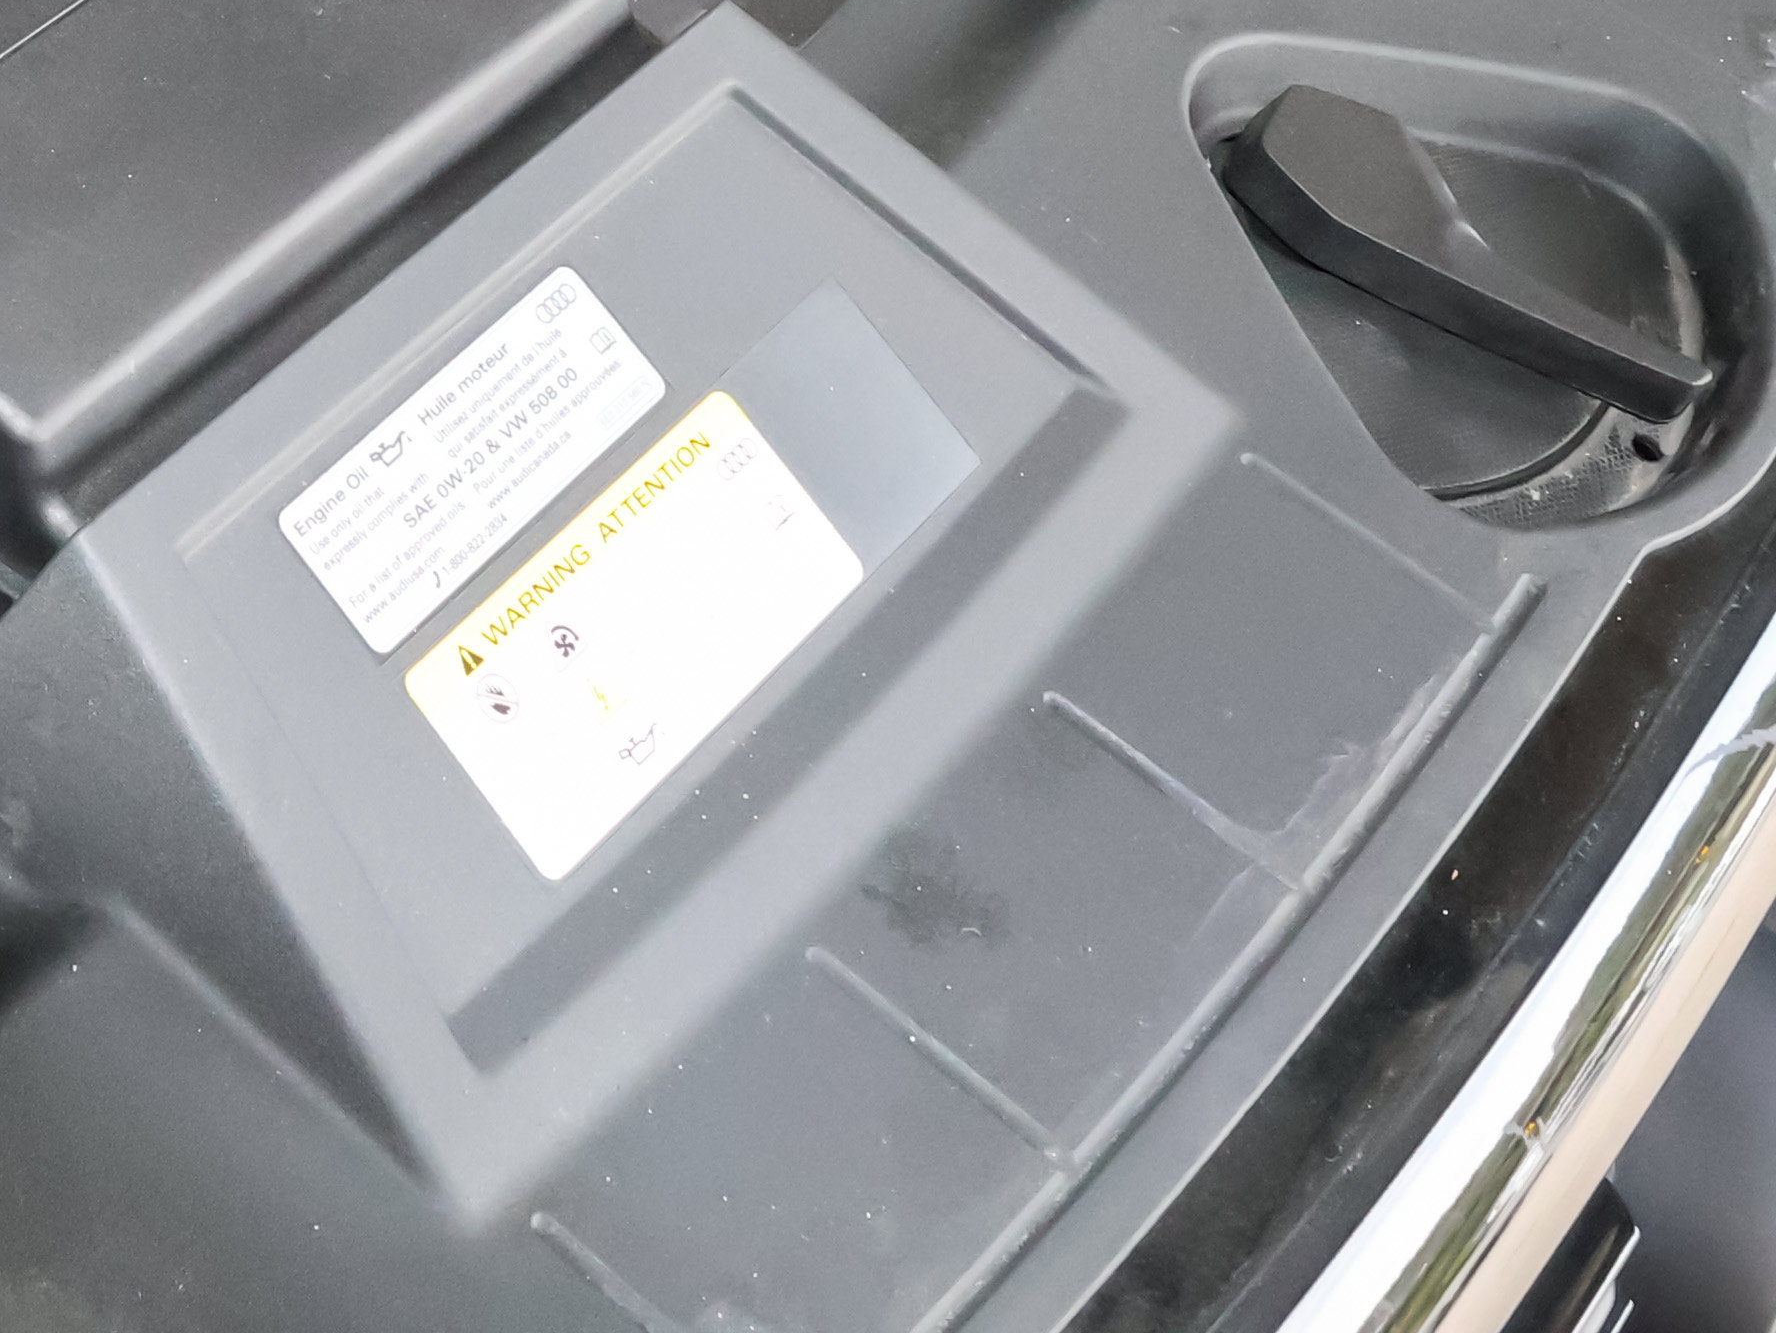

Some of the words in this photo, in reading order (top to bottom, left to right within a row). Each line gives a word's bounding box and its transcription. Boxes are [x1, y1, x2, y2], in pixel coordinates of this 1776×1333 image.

[417, 389, 458, 427] Huile
[456, 343, 510, 394] moteur
[433, 410, 469, 444] Utilisez
[468, 364, 522, 416] uniquement
[520, 352, 536, 368] de
[403, 494, 438, 529] SAE
[436, 449, 486, 500] 0W-20
[484, 437, 502, 455] &
[498, 409, 530, 440] VW
[528, 384, 559, 415] 508
[555, 366, 579, 390] 00
[447, 442, 465, 459] qui
[463, 409, 499, 446] satisfait
[471, 472, 496, 495] Pour
[497, 453, 516, 475] une
[513, 436, 537, 458] liste
[486, 431, 573, 510] www.audicanada.ca
[293, 488, 347, 538] Engine
[346, 465, 370, 490] Oil
[309, 537, 330, 556] Use
[330, 517, 353, 541] only
[350, 503, 367, 521] oil
[363, 486, 386, 505] that
[323, 529, 370, 572] expressly
[367, 490, 410, 532] complies
[406, 471, 430, 495] with
[482, 541, 591, 648] WARNING
[599, 430, 713, 543] ATTENTION
[348, 589, 370, 610] For
[369, 582, 378, 593] a
[374, 566, 393, 587] list
[391, 554, 404, 571] of
[402, 518, 448, 564] approved
[442, 511, 509, 576] 1-800-822-2834
[362, 544, 446, 624] www.audiusa.com
